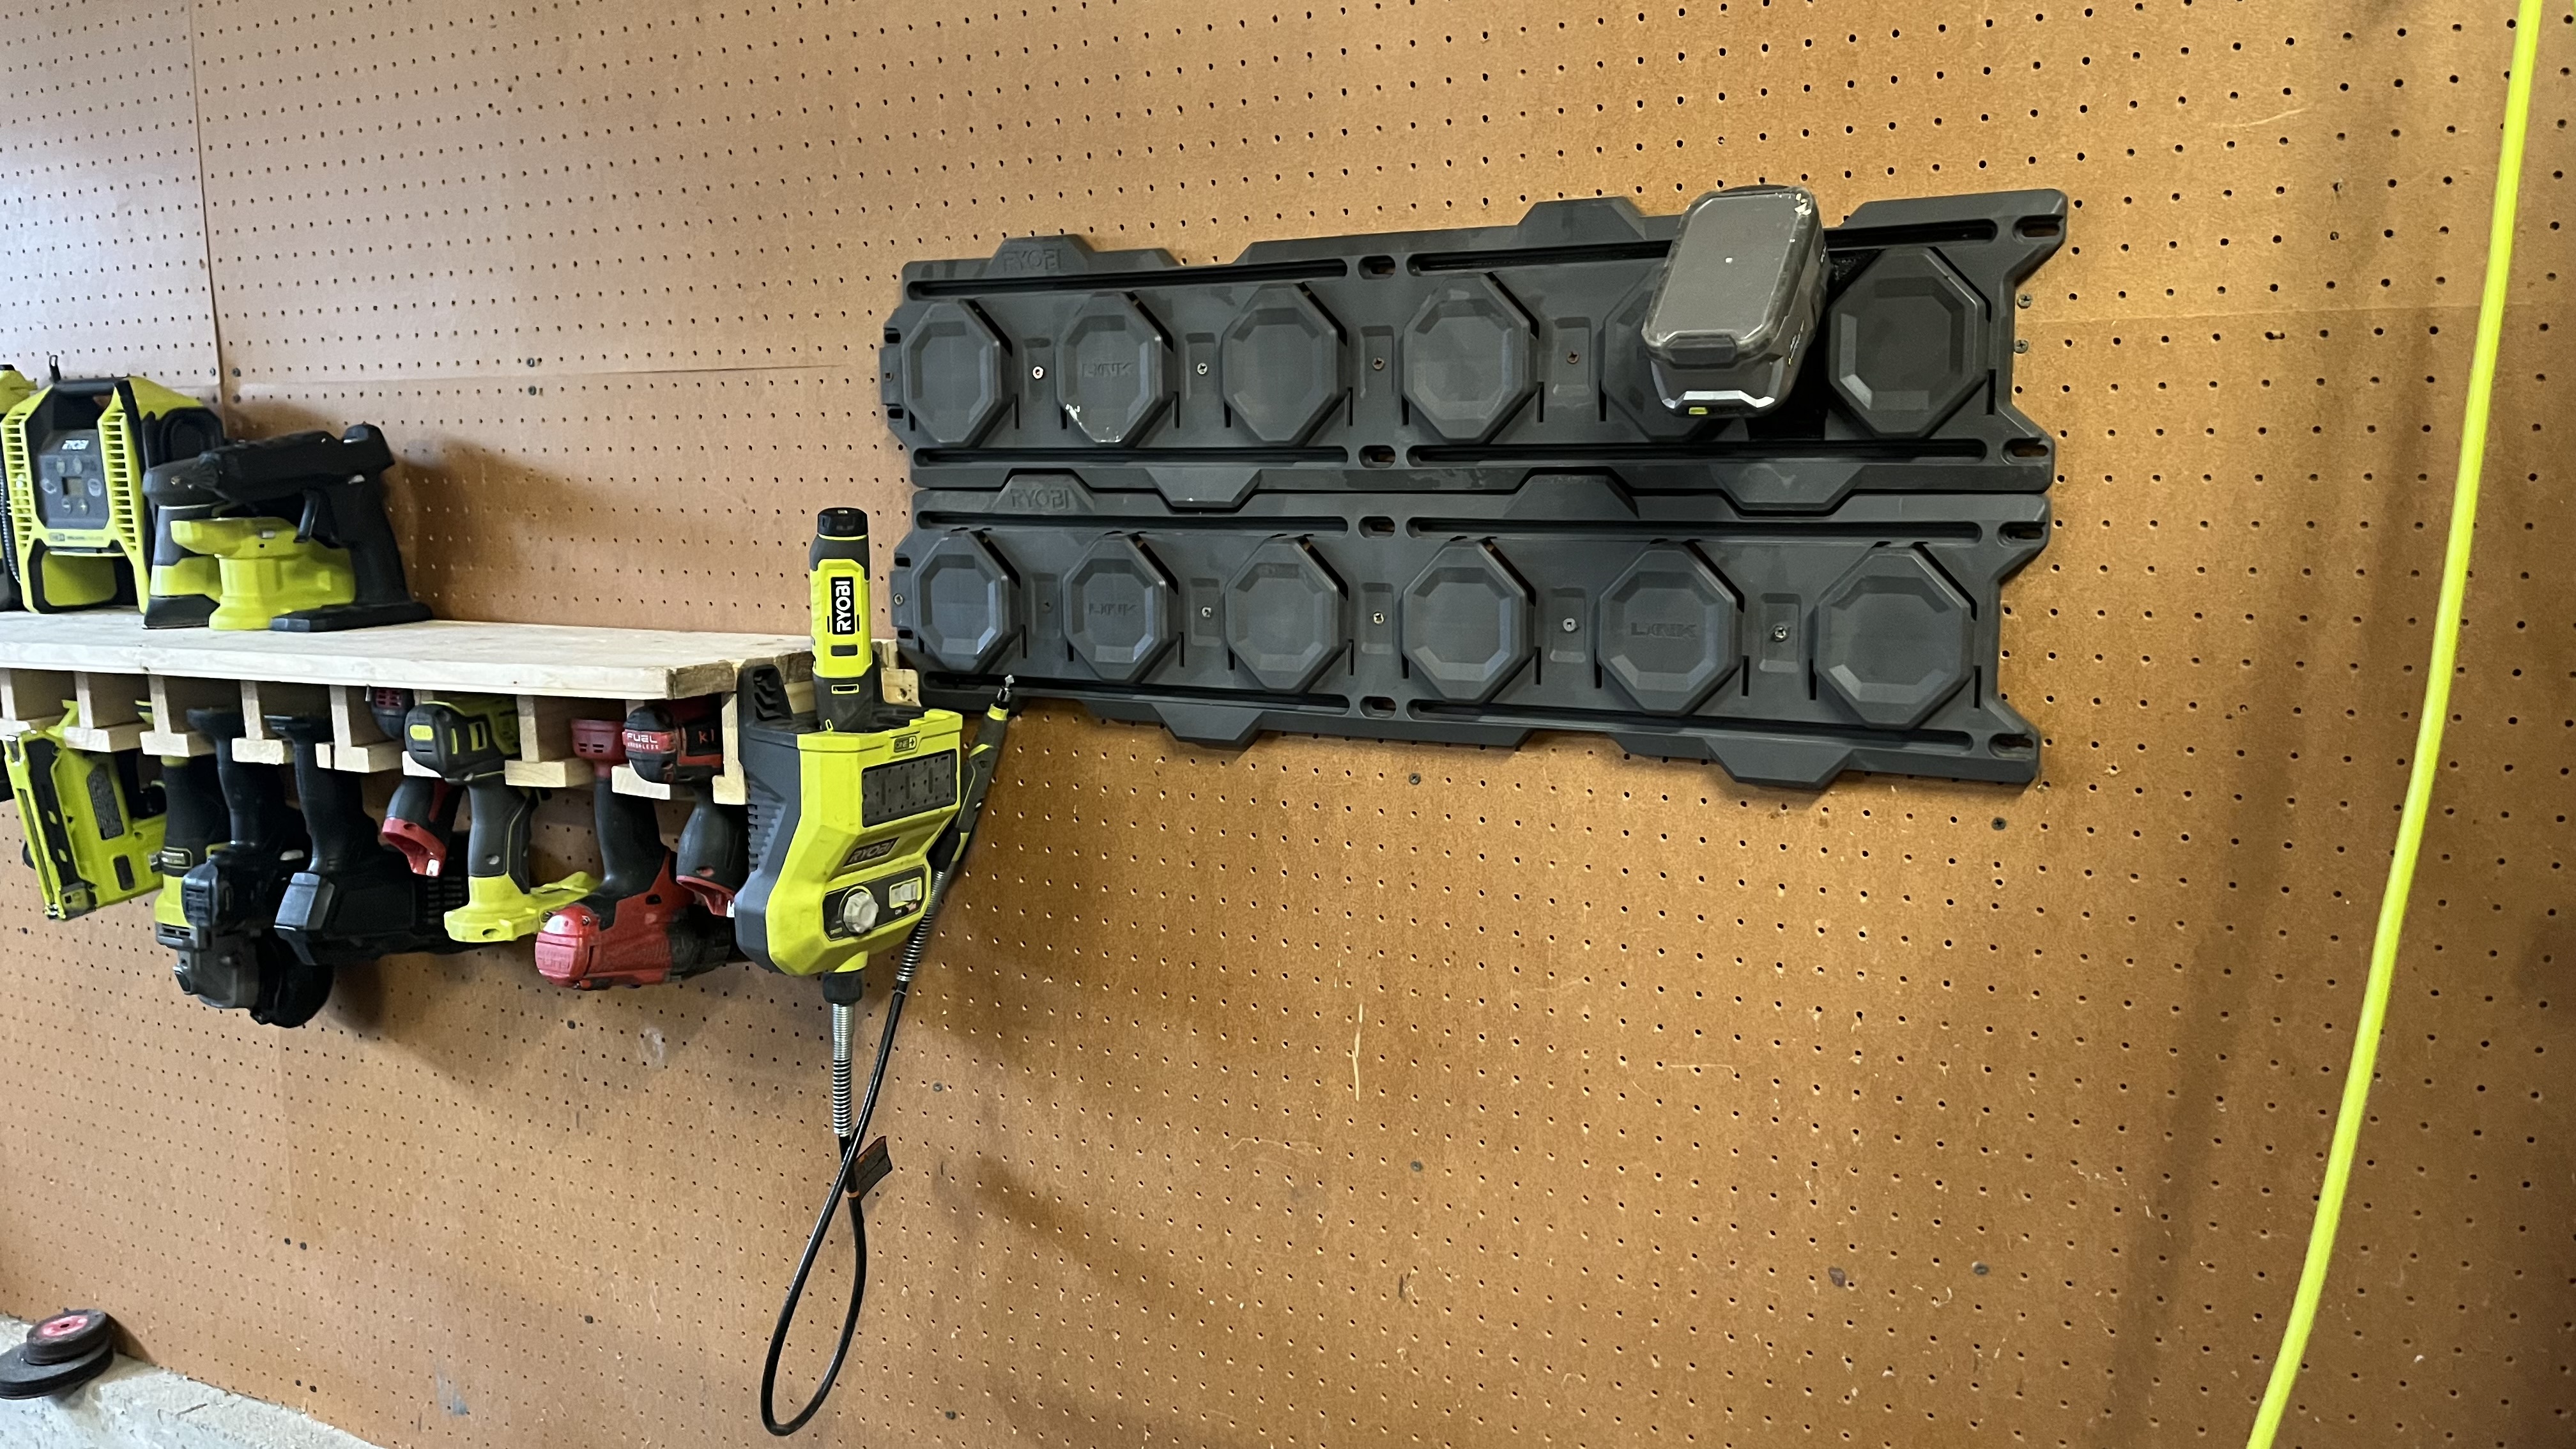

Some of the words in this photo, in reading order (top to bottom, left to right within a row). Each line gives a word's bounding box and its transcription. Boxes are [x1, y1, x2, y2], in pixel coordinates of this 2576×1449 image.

[1002, 249, 1062, 272] RYOBI
[1009, 489, 1069, 509] RYOBI
[835, 580, 852, 632] RYOBI
[627, 732, 658, 744] FUEL
[848, 841, 894, 863] RYOBI
